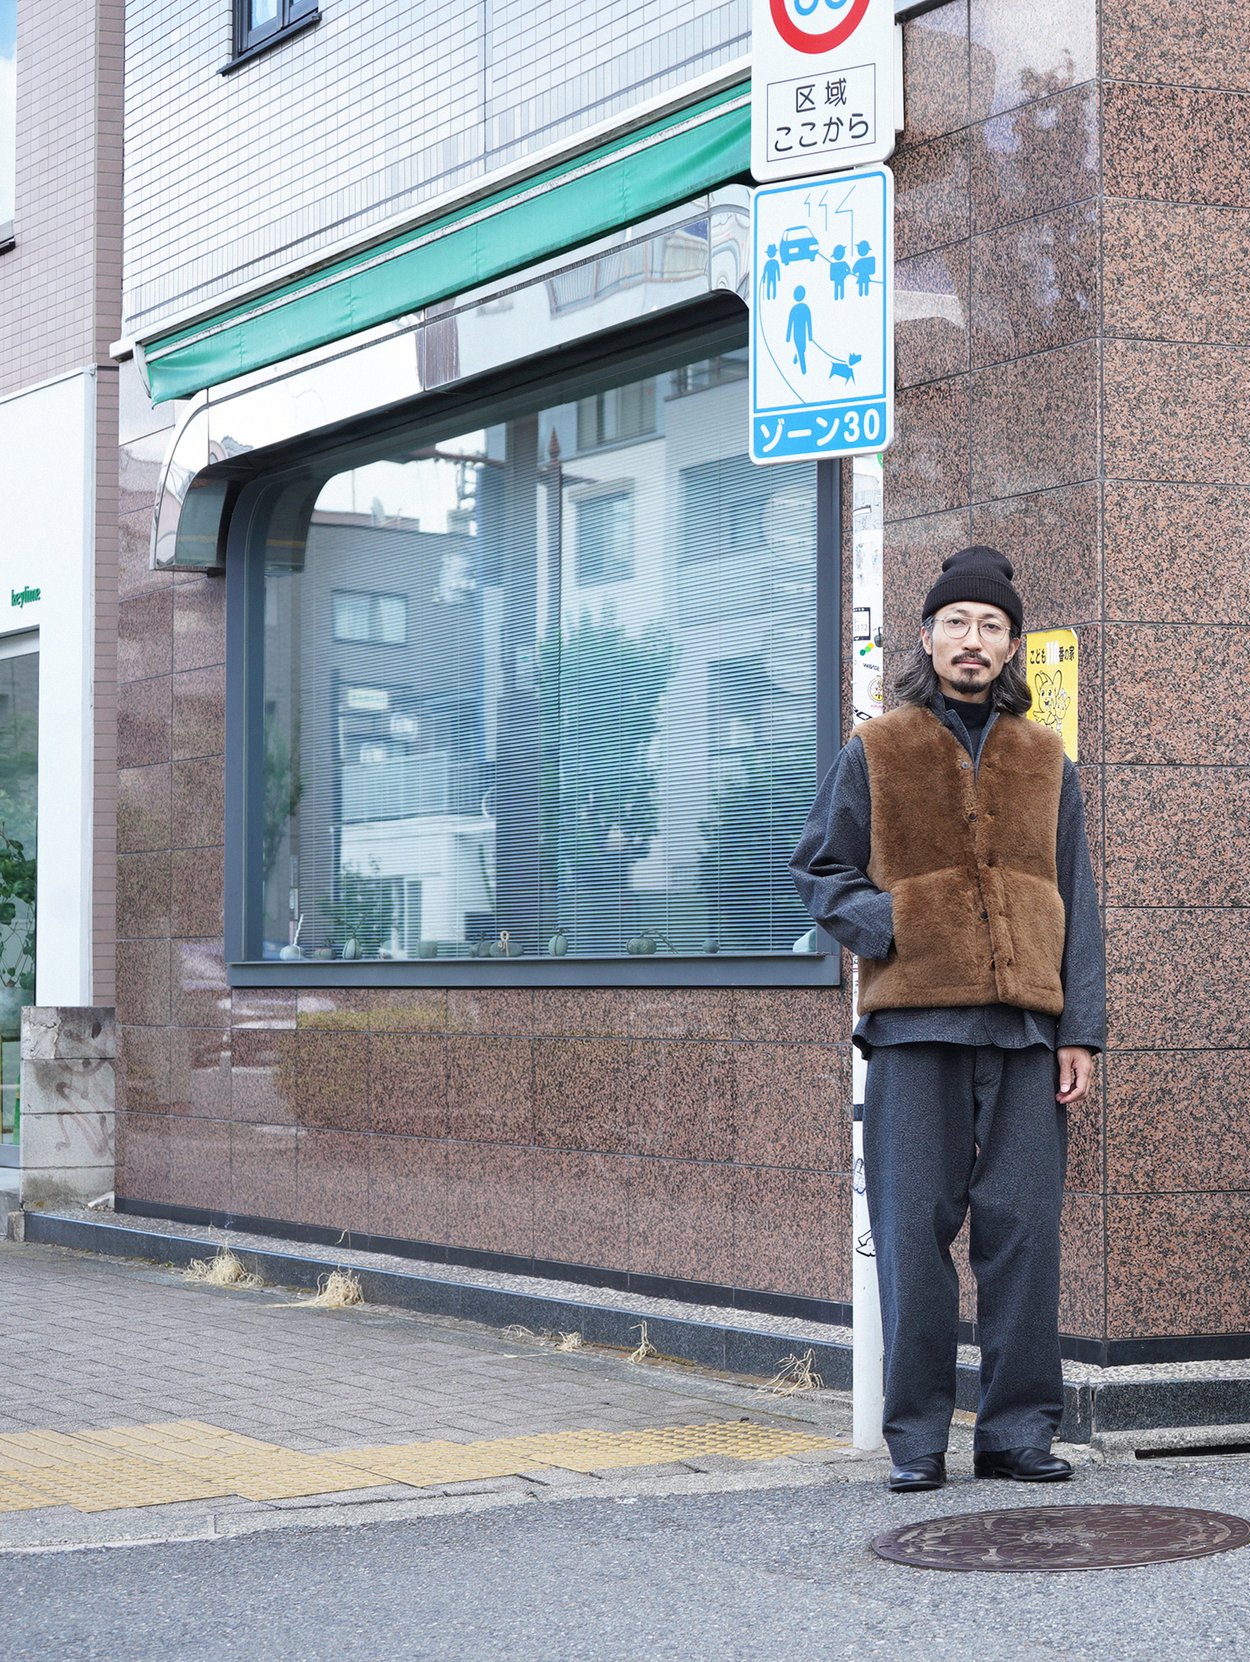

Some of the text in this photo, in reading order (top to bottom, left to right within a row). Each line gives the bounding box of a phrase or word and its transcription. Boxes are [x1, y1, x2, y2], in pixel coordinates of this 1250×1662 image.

[796, 77, 847, 113] 区域
[774, 113, 869, 152] ここから
[760, 408, 880, 453] ゾーン30
